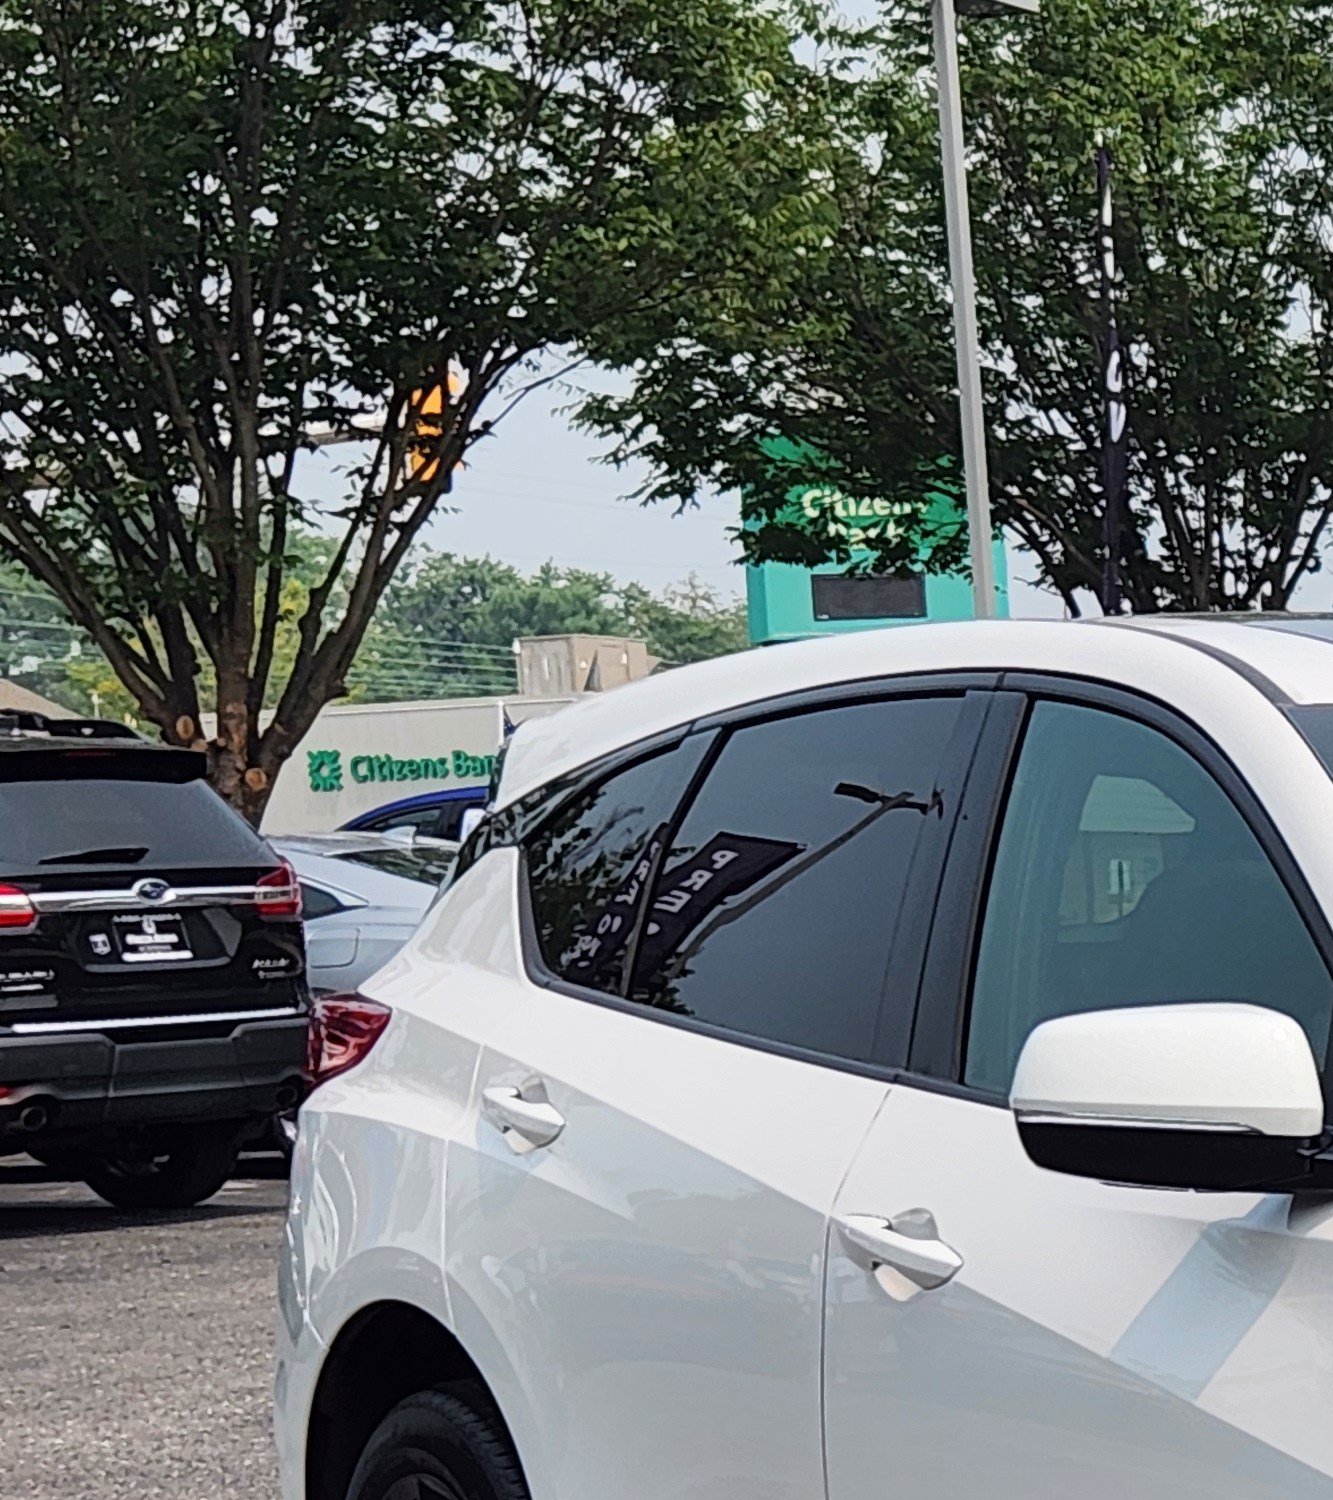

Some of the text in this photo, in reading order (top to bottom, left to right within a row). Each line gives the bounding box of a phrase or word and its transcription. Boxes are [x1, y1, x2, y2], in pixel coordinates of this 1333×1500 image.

[802, 488, 928, 519] Citizen
[350, 749, 498, 784] Citizens Ban
